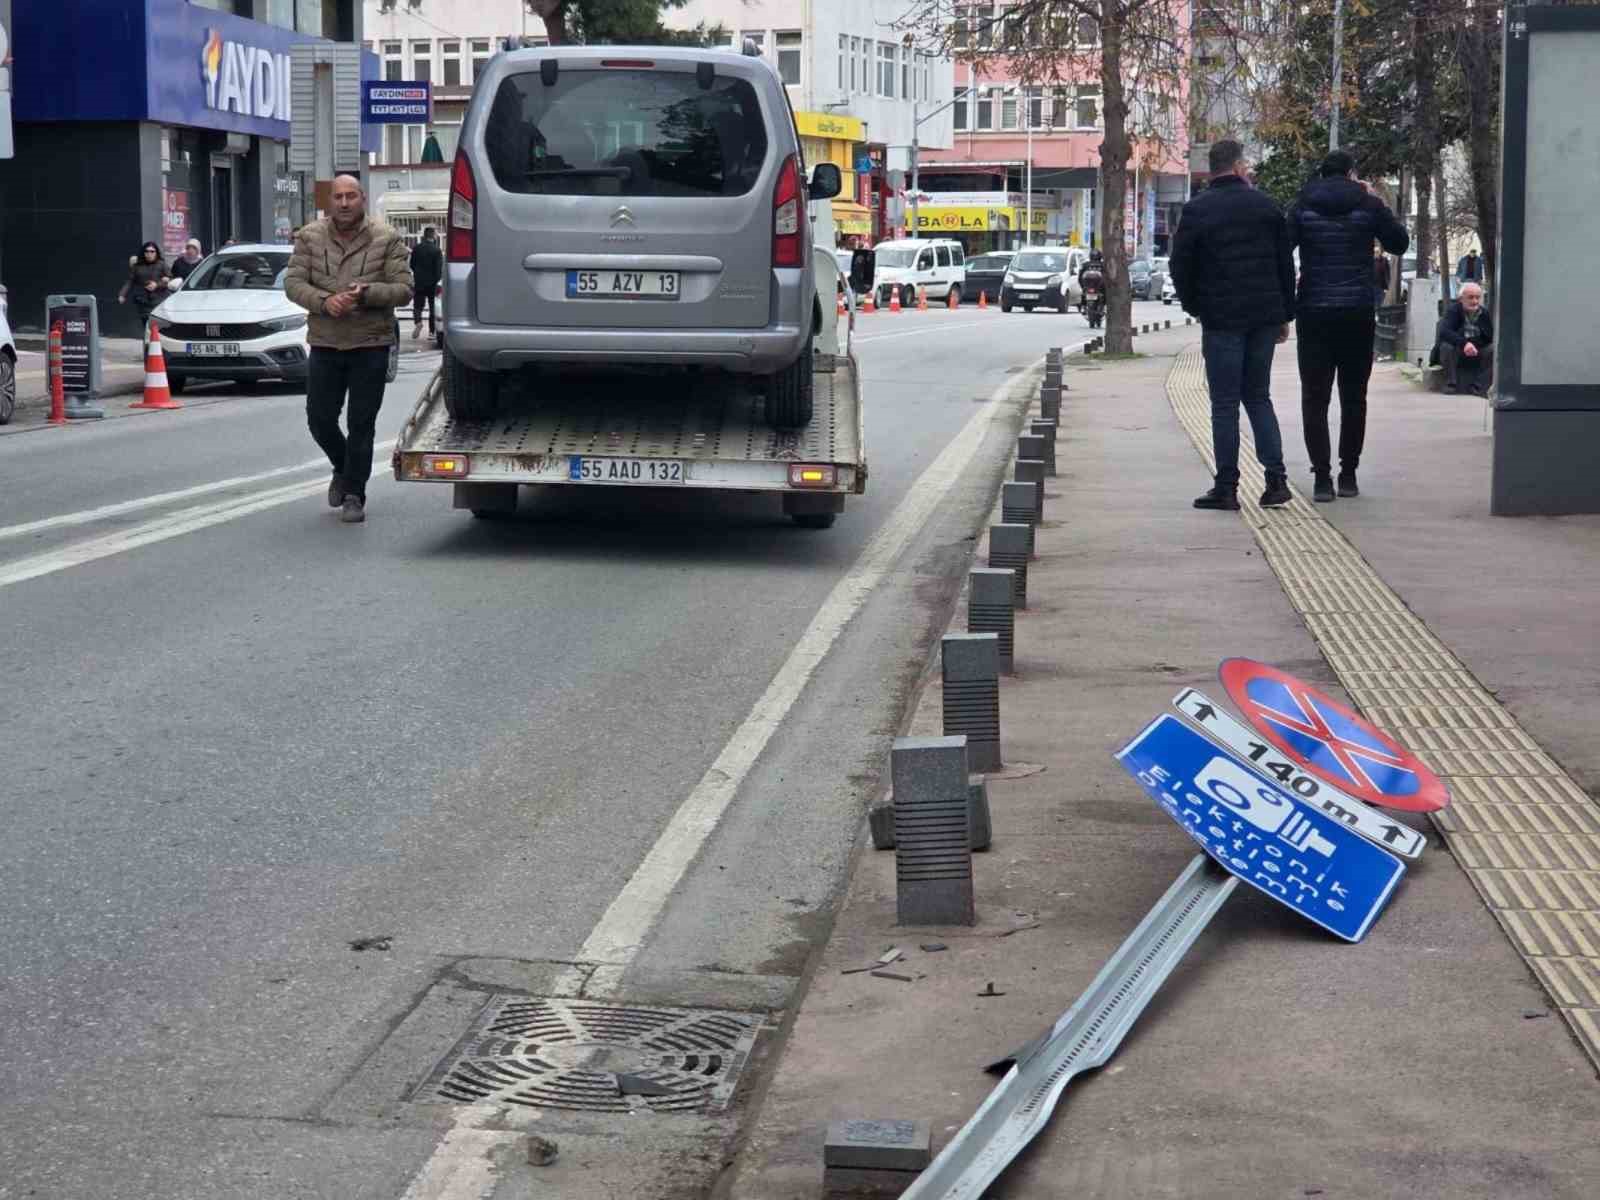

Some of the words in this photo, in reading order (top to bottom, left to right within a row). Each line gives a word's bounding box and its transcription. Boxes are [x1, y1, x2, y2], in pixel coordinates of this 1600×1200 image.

[579, 273, 598, 291] 55
[612, 274, 643, 292] AZV
[659, 274, 675, 292] 13
[582, 460, 603, 479] 55
[608, 461, 641, 479] AAD
[649, 461, 681, 481] 132
[1248, 741, 1319, 798] 140
[1322, 800, 1359, 826] m
[1137, 770, 1345, 912] Denetleme
[1149, 764, 1349, 899] Elektronik
